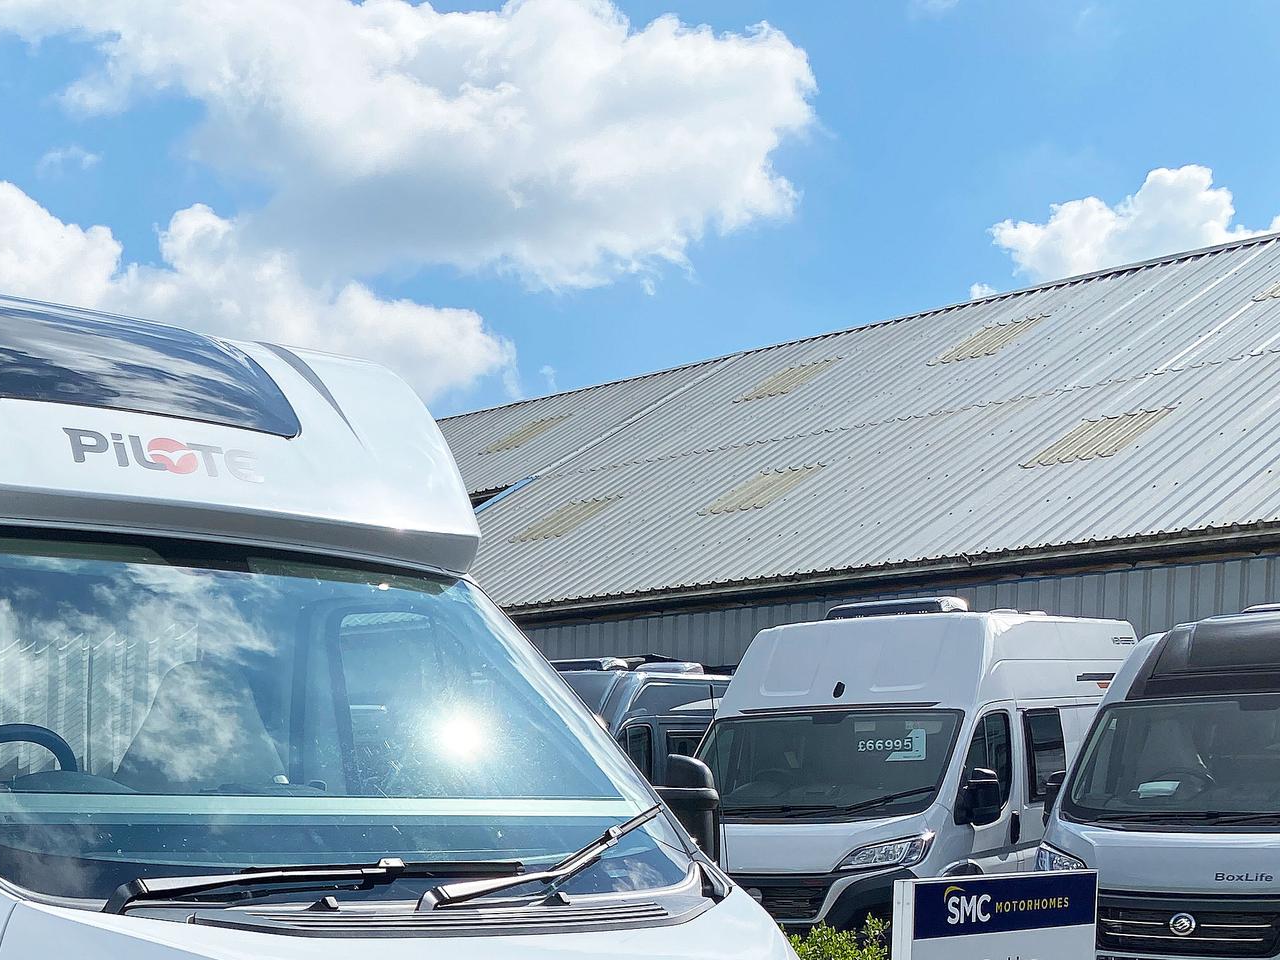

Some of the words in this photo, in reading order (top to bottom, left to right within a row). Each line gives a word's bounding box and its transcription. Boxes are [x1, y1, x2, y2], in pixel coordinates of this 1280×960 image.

[857, 739, 913, 752] £66995
[1214, 872, 1274, 882] BoxLife
[946, 893, 992, 925] SMC
[995, 896, 1070, 913] MOTORHOMES
